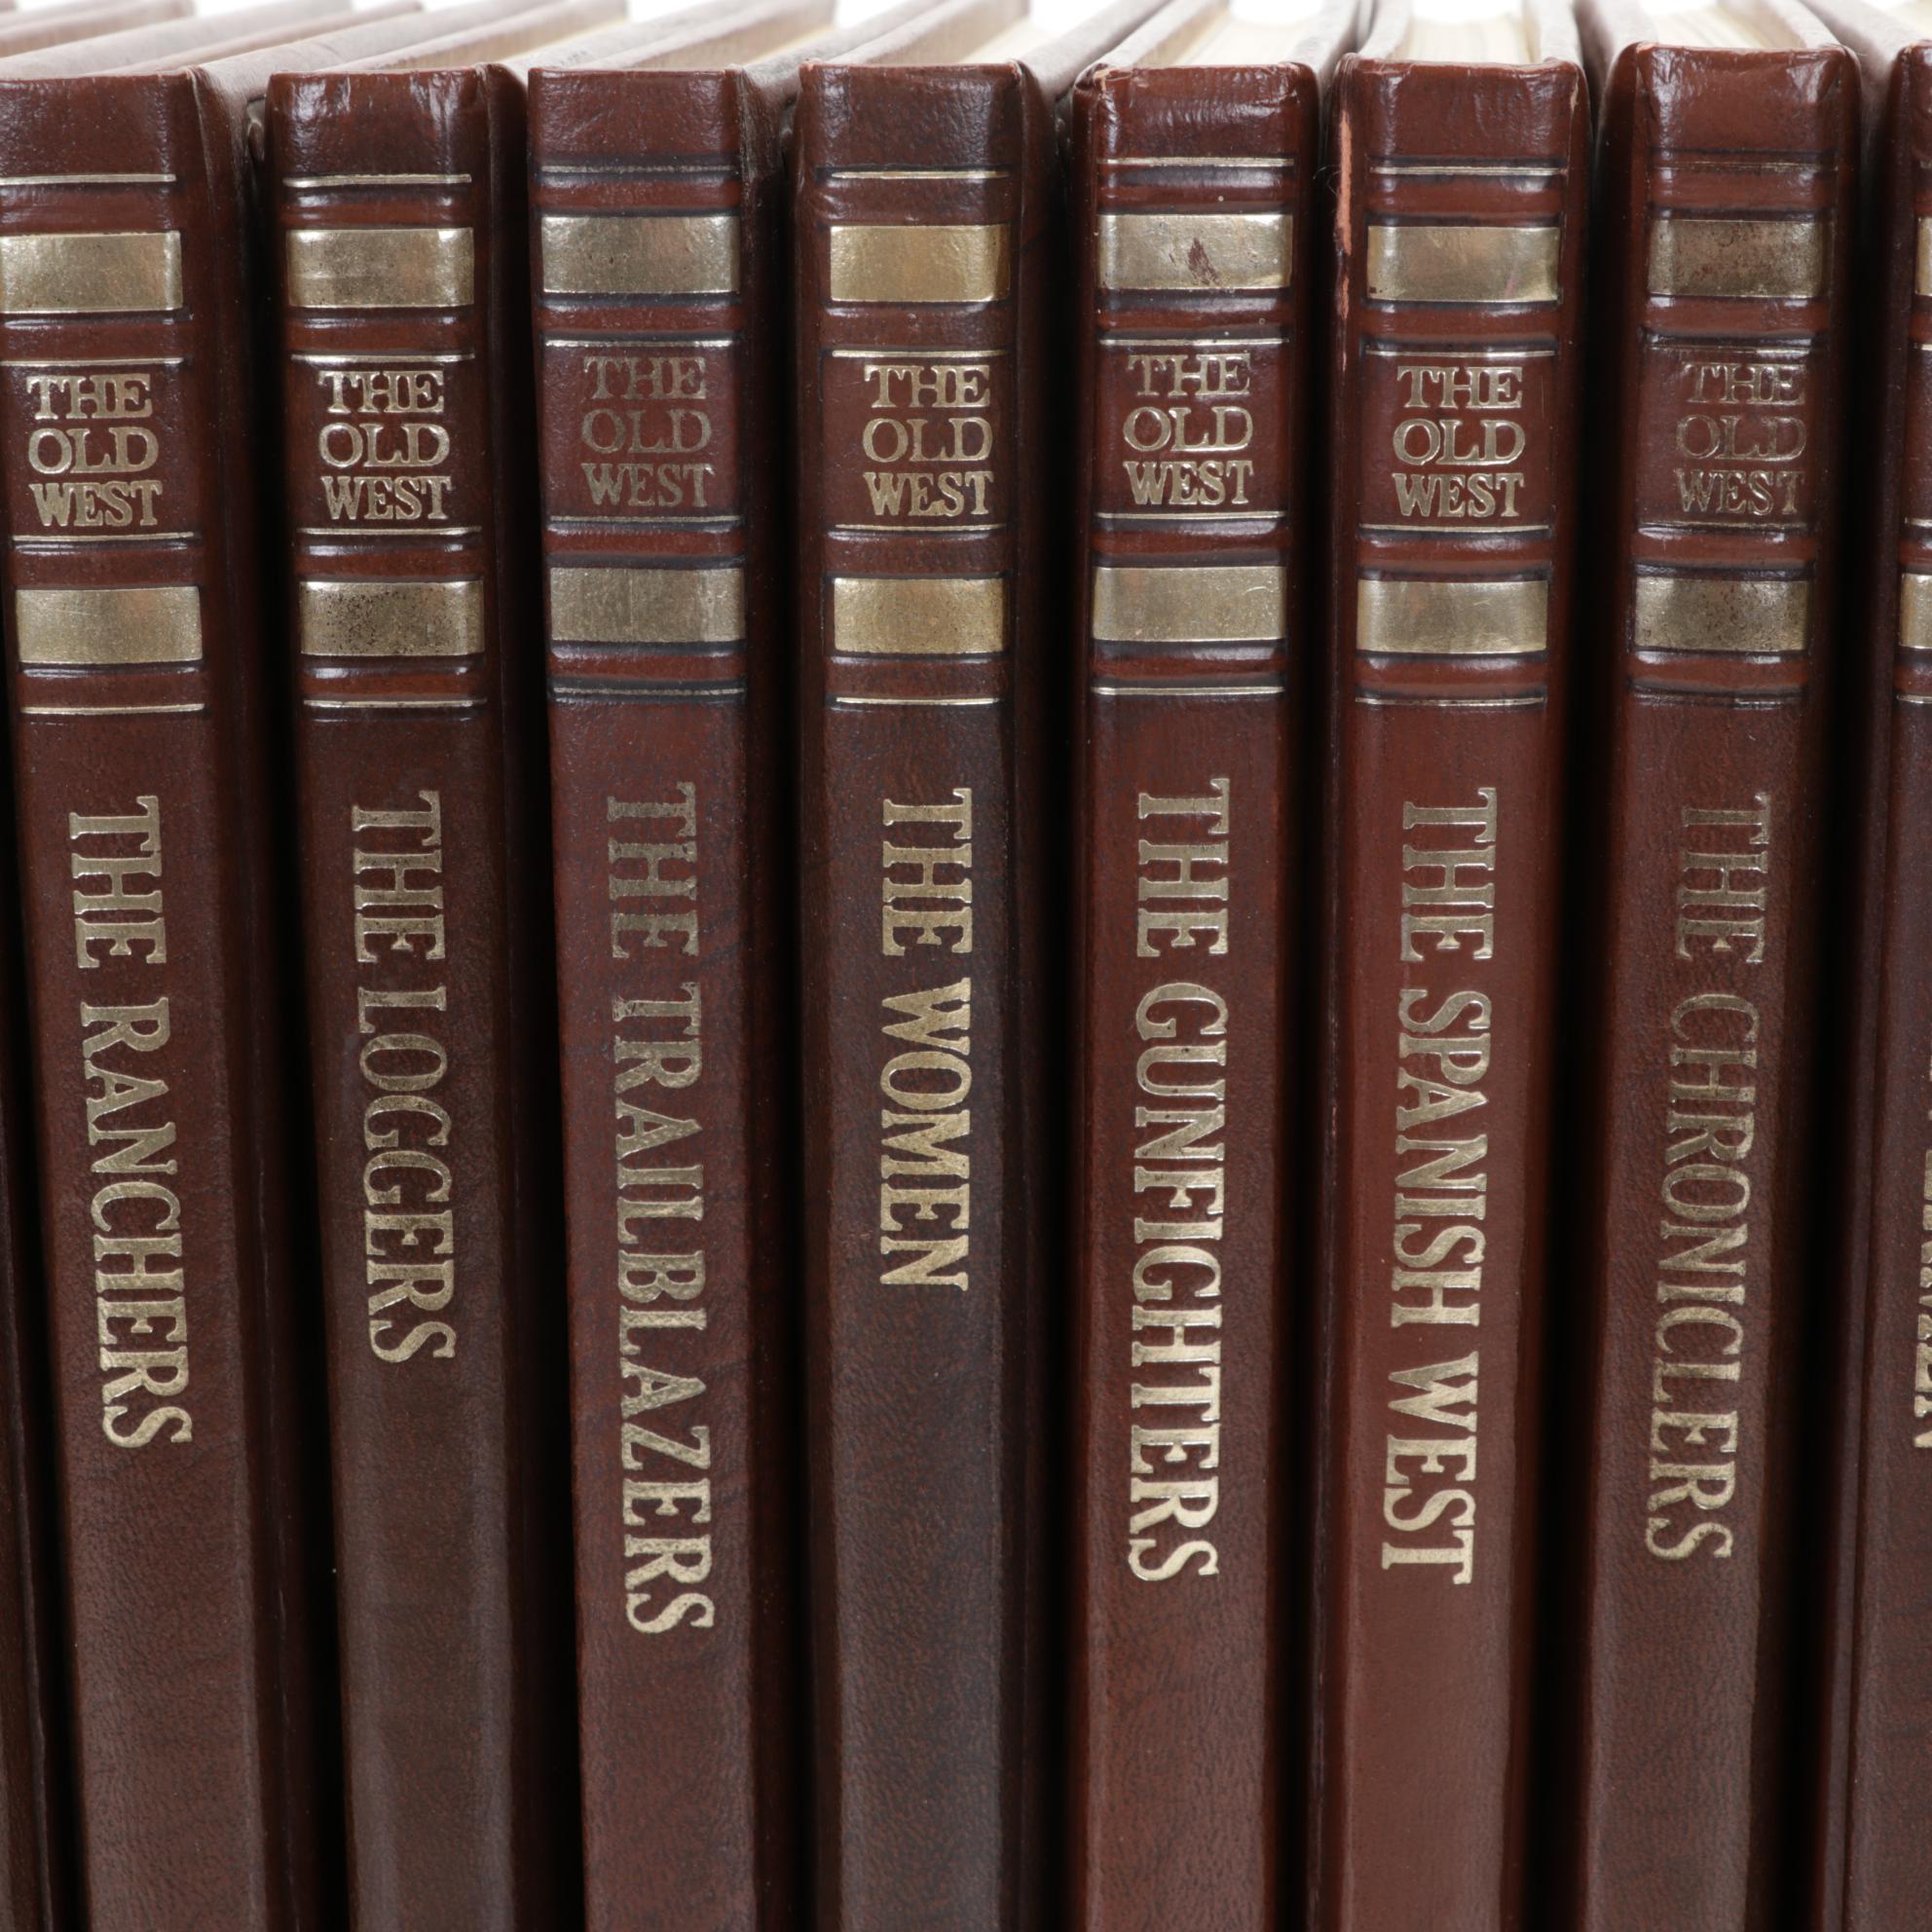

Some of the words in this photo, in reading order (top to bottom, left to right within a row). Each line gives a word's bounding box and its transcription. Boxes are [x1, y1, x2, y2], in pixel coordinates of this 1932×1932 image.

[27, 374, 152, 420] THE
[318, 370, 445, 414] THE
[583, 356, 706, 400] THE
[863, 365, 990, 408] THE
[1129, 353, 1250, 396] THE
[1396, 366, 1523, 409] THE
[1682, 362, 1805, 405] THE
[28, 426, 159, 474] OLD
[318, 423, 446, 467] OLD
[582, 409, 711, 454] OLD
[862, 417, 993, 463] OLD
[1123, 406, 1253, 451] OLD
[1393, 418, 1525, 464] OLD
[1676, 415, 1806, 462] OLD
[29, 480, 163, 527] WEST
[320, 475, 452, 520] WEST
[581, 464, 714, 508] WEST
[863, 471, 993, 516] WEST
[1123, 460, 1253, 505] WEST
[1393, 473, 1524, 517] WEST
[1674, 468, 1804, 515] WEST
[69, 796, 167, 968] THE
[352, 791, 446, 963] THE
[607, 782, 699, 958] THE
[881, 788, 972, 956] THE
[1136, 778, 1230, 957] THE
[1400, 787, 1497, 961] THE
[1676, 792, 1770, 963] THE
[879, 977, 972, 1291] WOMEN
[1391, 988, 1491, 1327] SPANISH
[357, 986, 457, 1362] LOGGERS
[80, 997, 193, 1448] RANCHERS
[1128, 983, 1229, 1580] GUNFIGHTERS
[1645, 993, 1760, 1559] CHRONICLERS
[612, 982, 715, 1633] TRAILBLAZERS
[1382, 1351, 1479, 1584] WEST
